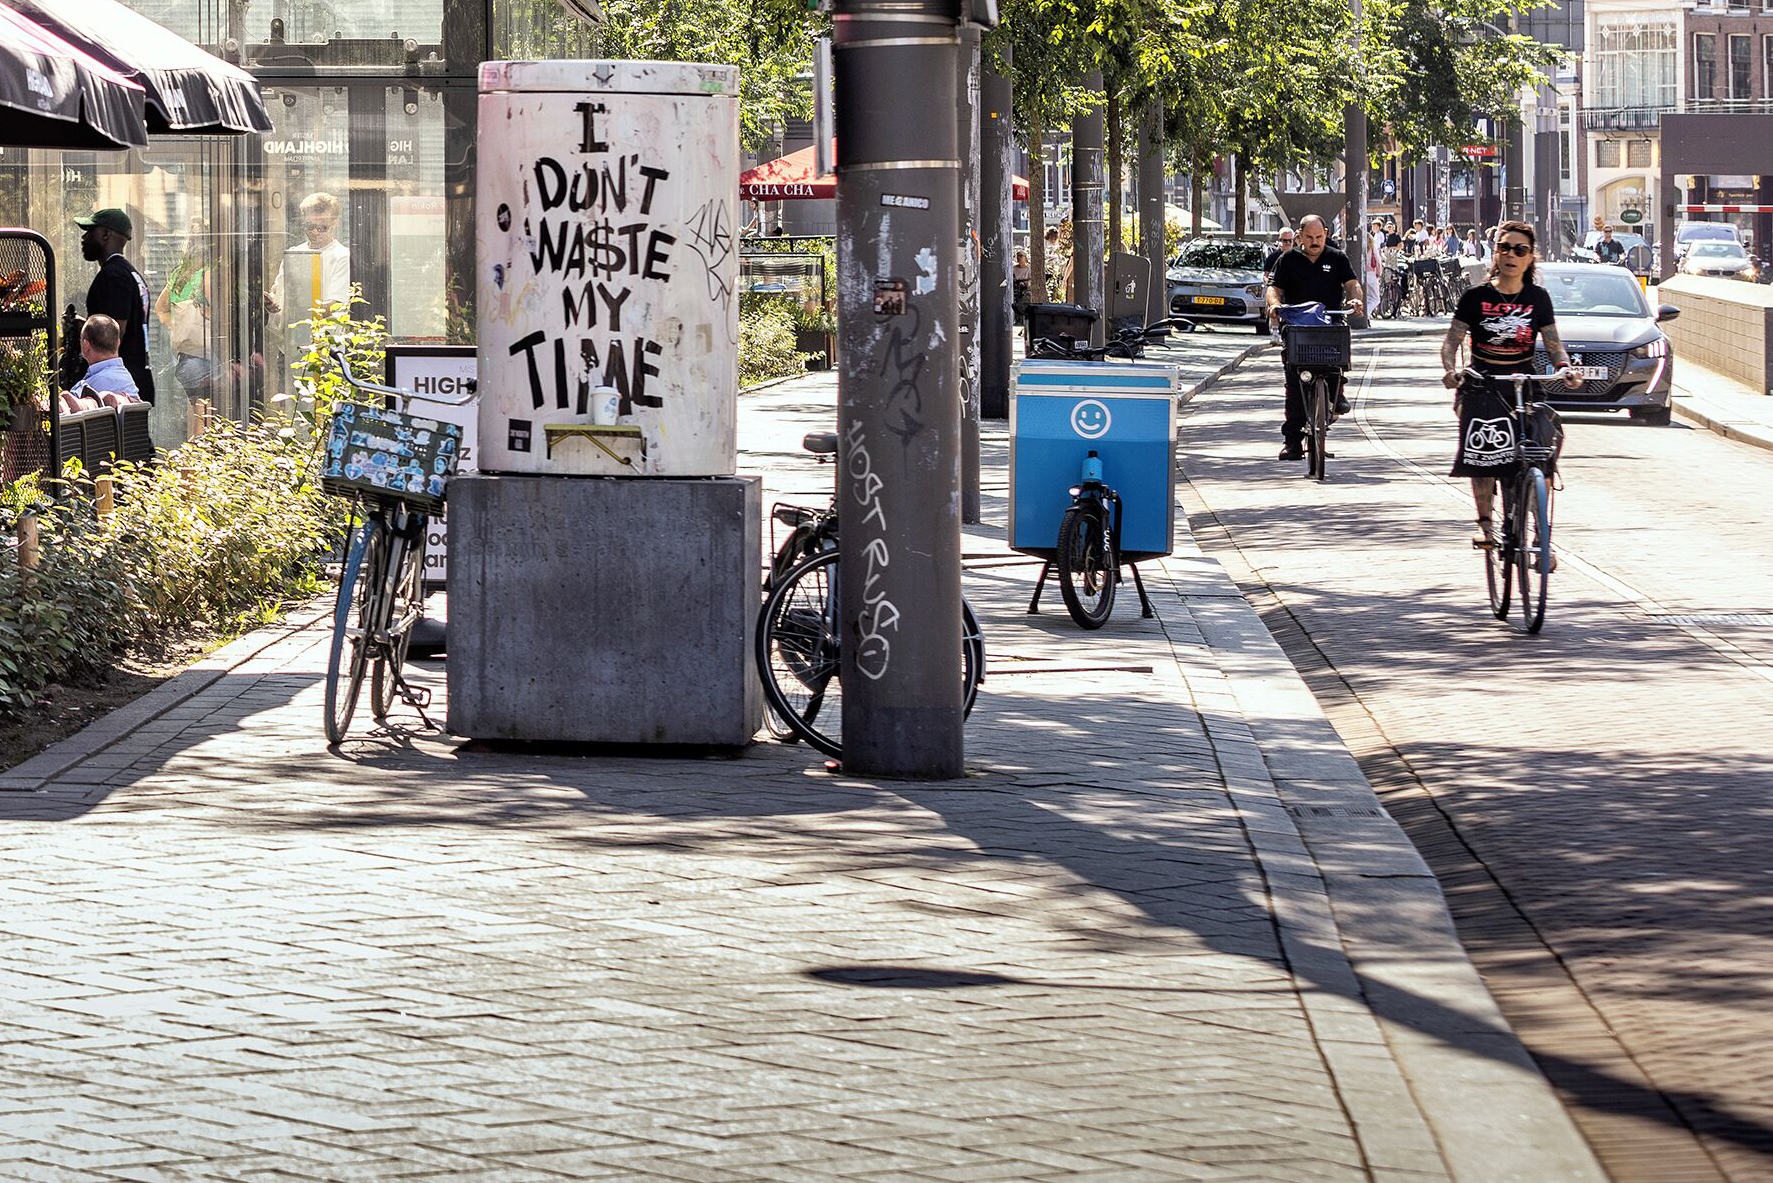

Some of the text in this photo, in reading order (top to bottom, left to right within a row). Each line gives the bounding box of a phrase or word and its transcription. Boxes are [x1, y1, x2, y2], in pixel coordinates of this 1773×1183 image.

[573, 102, 609, 153] I
[534, 153, 670, 215] DON'T
[749, 184, 779, 195] CHA
[783, 184, 814, 196] CHA
[562, 280, 631, 333] MY
[509, 329, 664, 417] TIME
